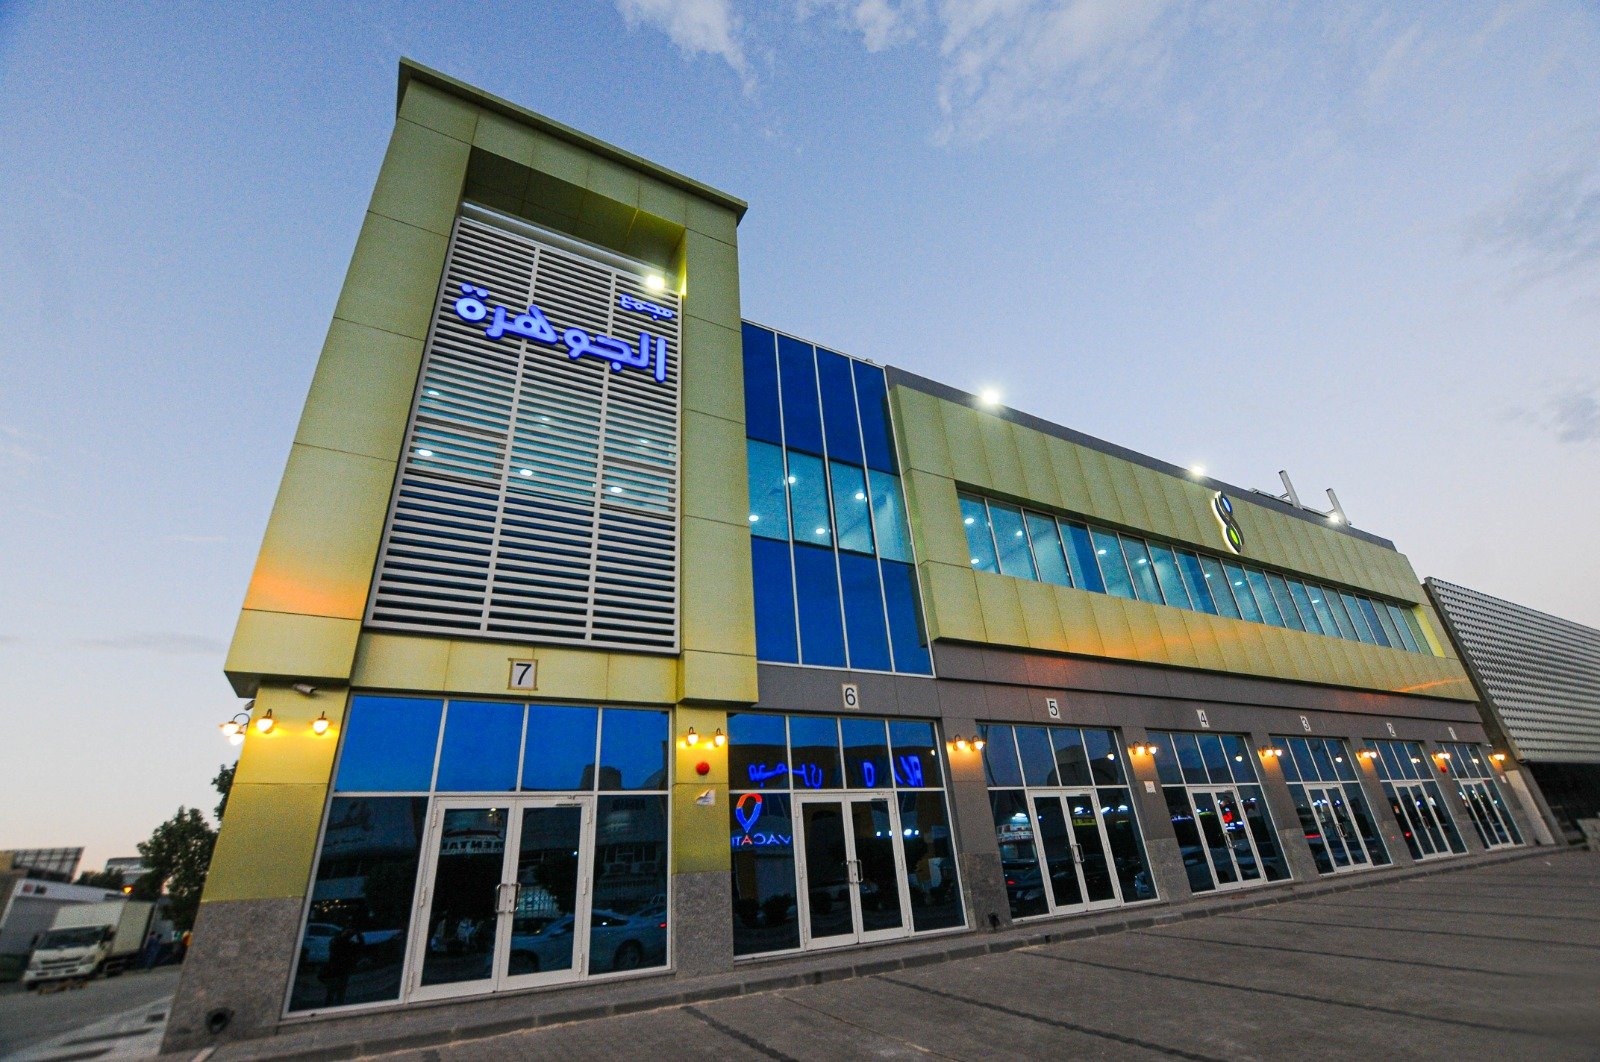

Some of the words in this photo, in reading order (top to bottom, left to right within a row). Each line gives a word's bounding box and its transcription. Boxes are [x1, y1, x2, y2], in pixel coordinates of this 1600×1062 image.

[618, 293, 675, 320] مجمع
[454, 283, 667, 383] الجوهرة
[515, 663, 532, 686] 7
[844, 687, 856, 706] 6
[1049, 700, 1059, 717] 5
[1199, 712, 1209, 726] 4
[1301, 717, 1310, 731] 3
[1387, 724, 1396, 737] 2
